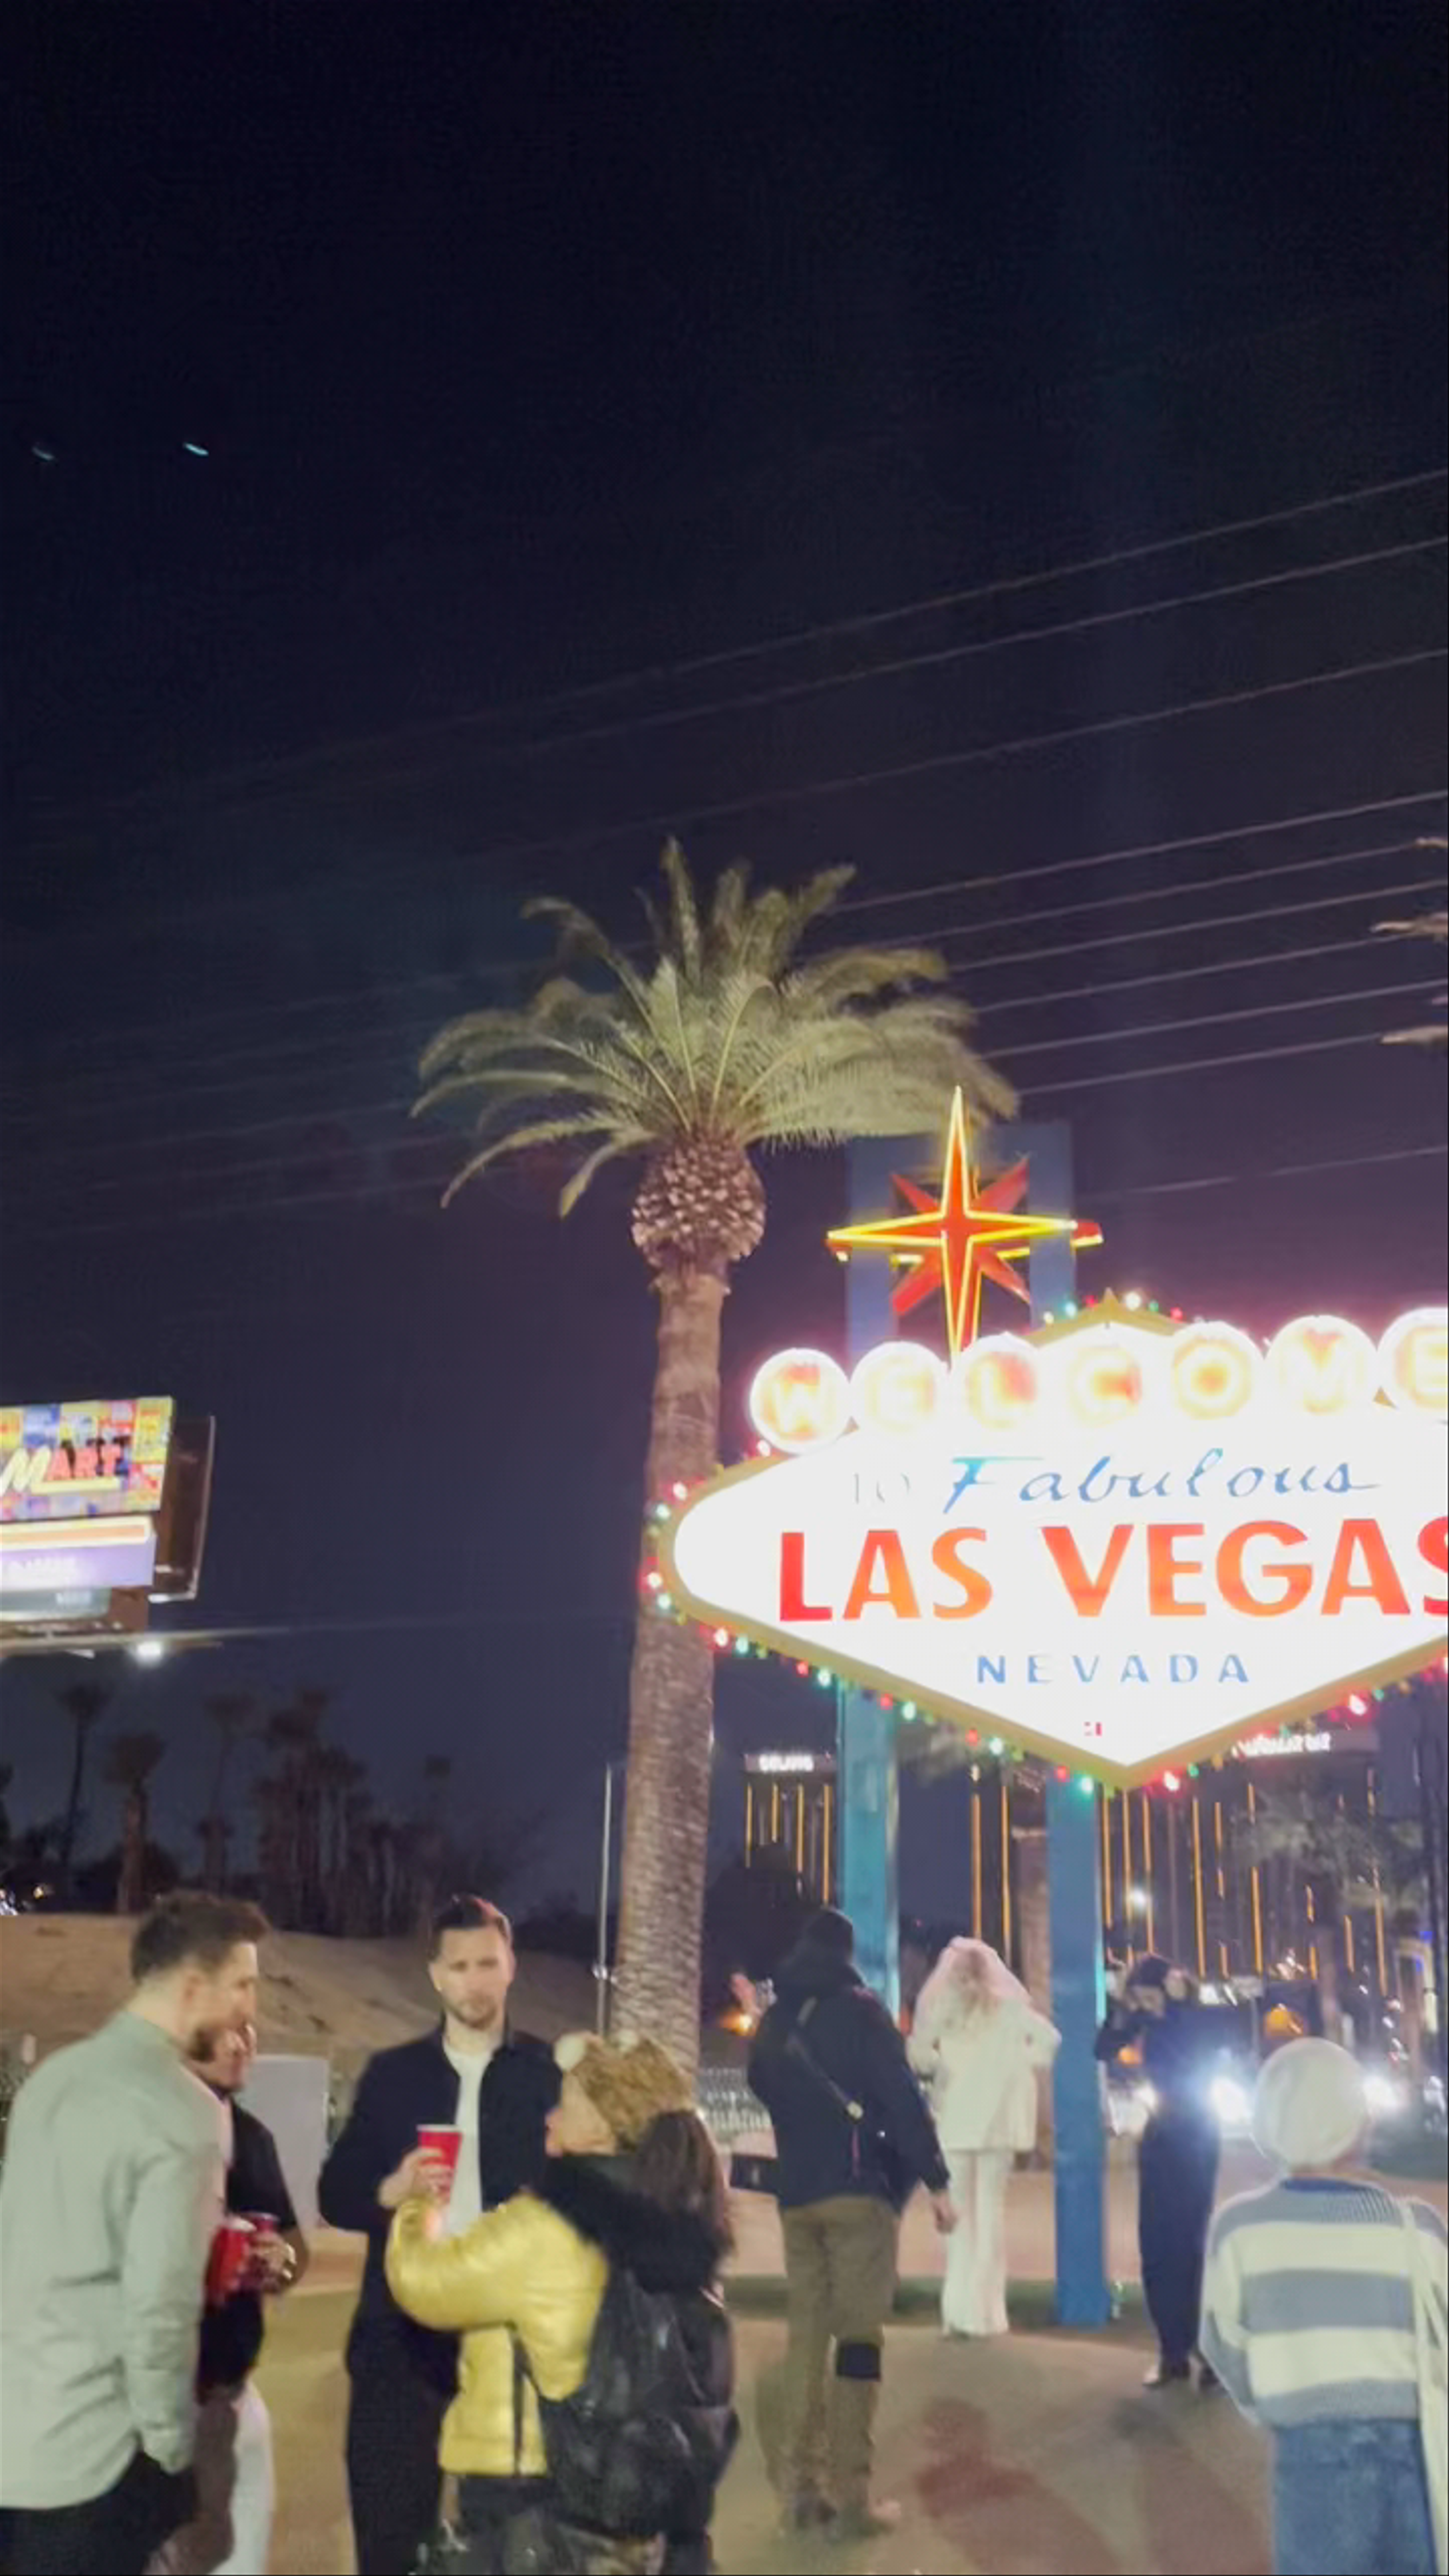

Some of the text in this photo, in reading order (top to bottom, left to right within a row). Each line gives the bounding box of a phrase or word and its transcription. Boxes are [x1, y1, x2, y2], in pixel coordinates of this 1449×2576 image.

[943, 1448, 1377, 1514] Fabulous
[780, 1527, 994, 1621] LAS
[977, 1654, 1249, 1684] NEVADA
